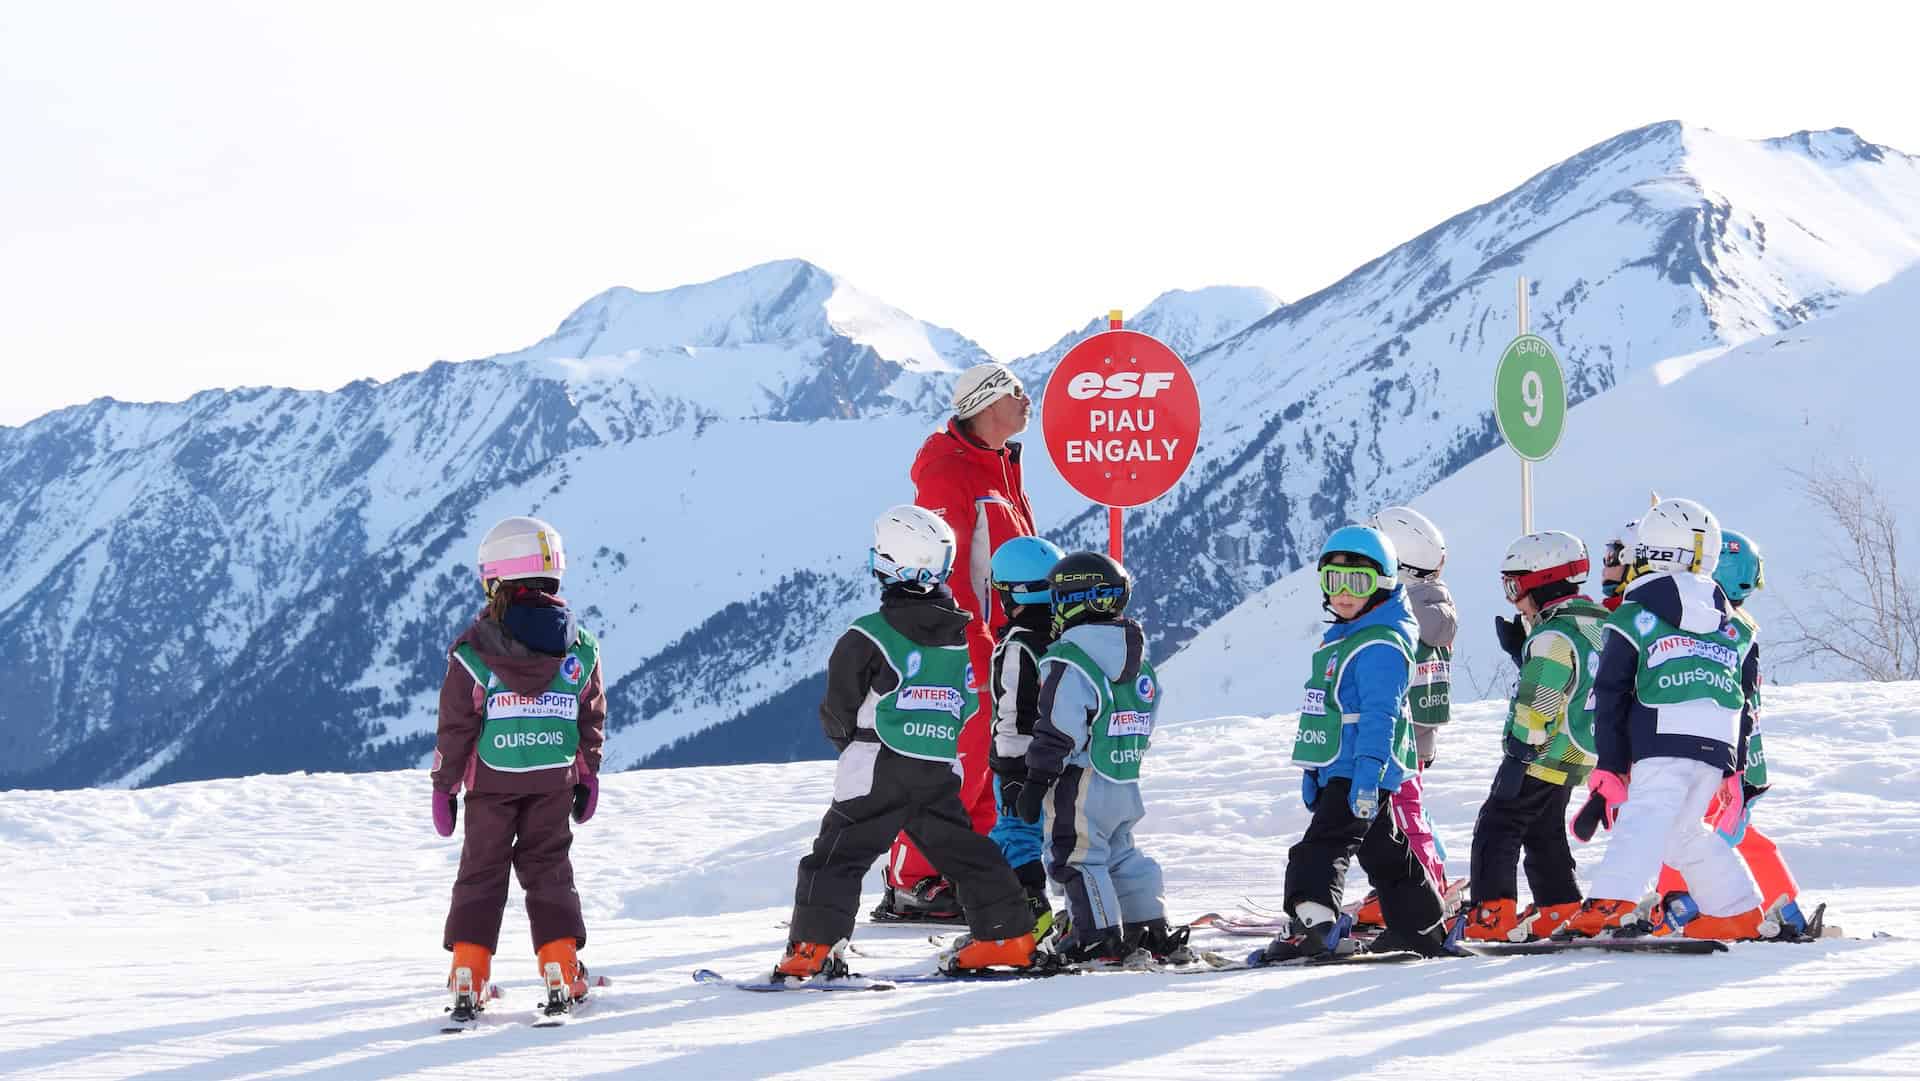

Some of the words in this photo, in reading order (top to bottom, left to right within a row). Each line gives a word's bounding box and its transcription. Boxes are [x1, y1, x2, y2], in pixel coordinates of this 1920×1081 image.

[1515, 341, 1547, 358] ISARD
[1521, 370, 1544, 428] 9
[1089, 409, 1155, 433] PIAU
[1066, 438, 1180, 463] ENGALY
[1659, 667, 1734, 694] OURSONS
[496, 694, 575, 708] INTERSPORT
[494, 731, 565, 749] OURSONS
[903, 722, 956, 741] OURSO
